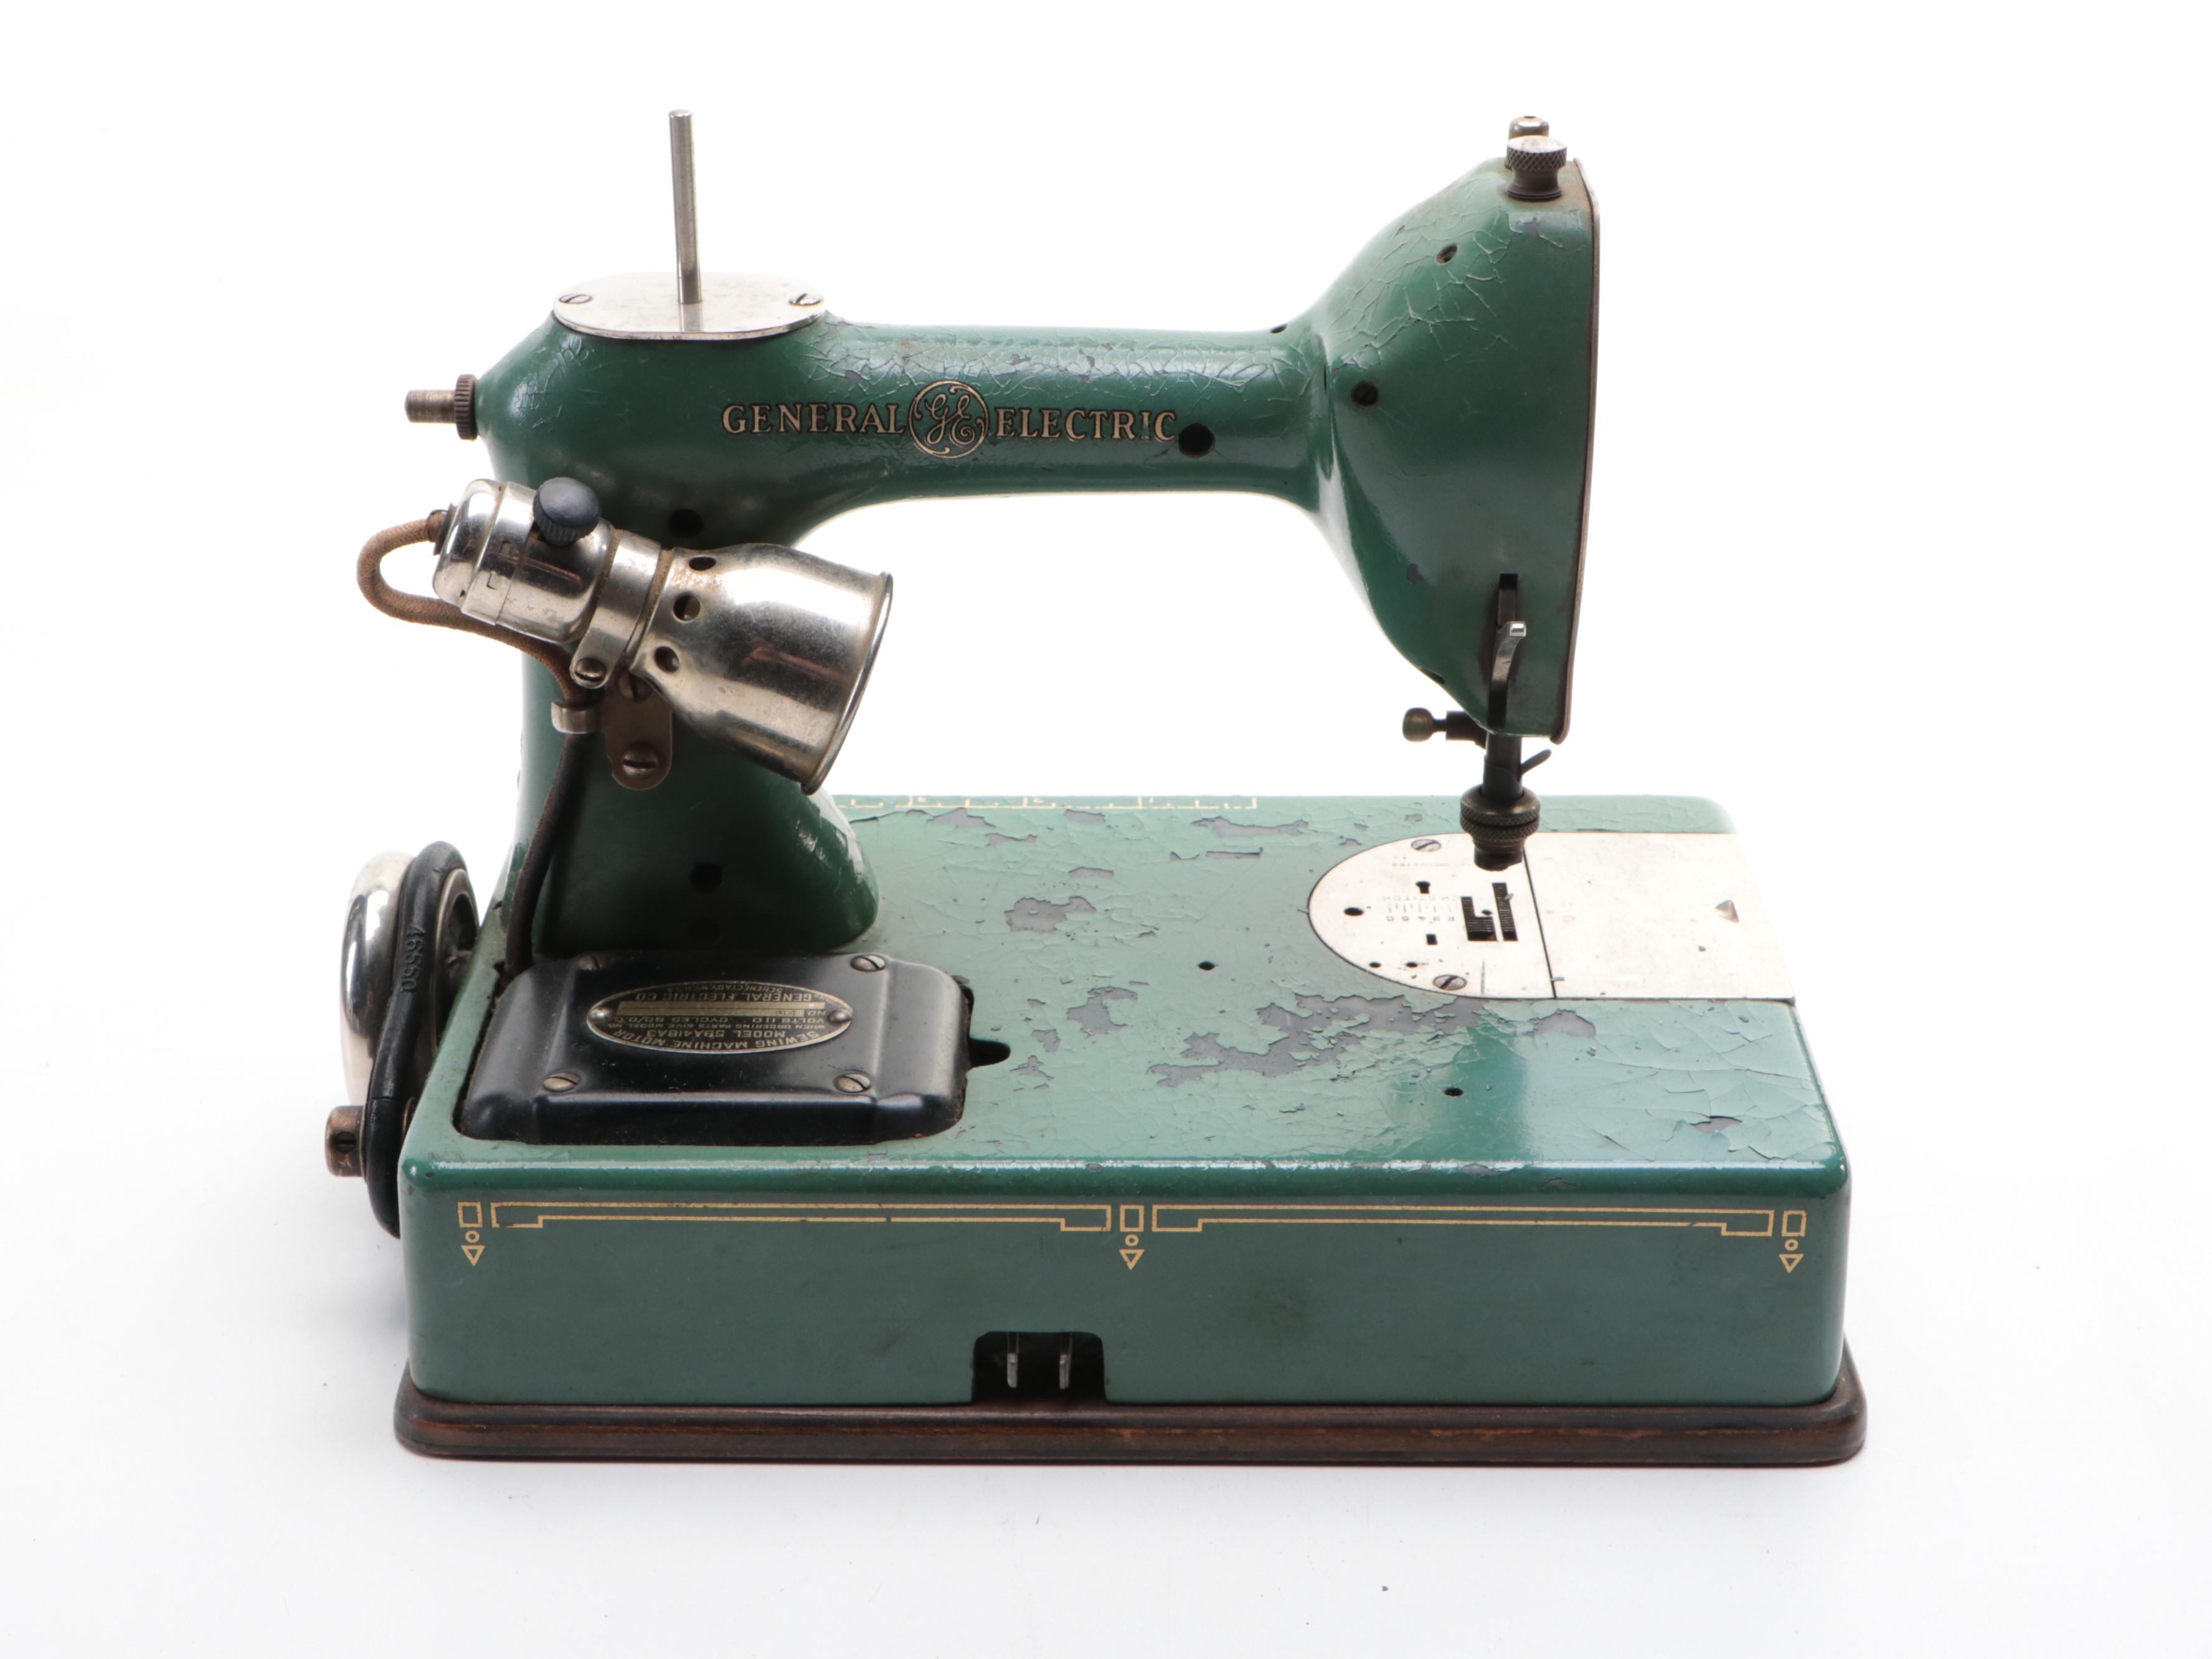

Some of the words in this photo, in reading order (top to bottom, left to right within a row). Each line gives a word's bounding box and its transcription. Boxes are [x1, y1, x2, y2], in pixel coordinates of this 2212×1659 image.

[721, 403, 907, 434] GENERAL
[996, 407, 1178, 442] ELECTRIC
[663, 993, 735, 1002] ELECTRIC
[742, 993, 813, 1002] GENERAL
[613, 1029, 666, 1046] MOTOR
[755, 1031, 820, 1047] SEWING
[672, 1041, 747, 1049] MACHINE
